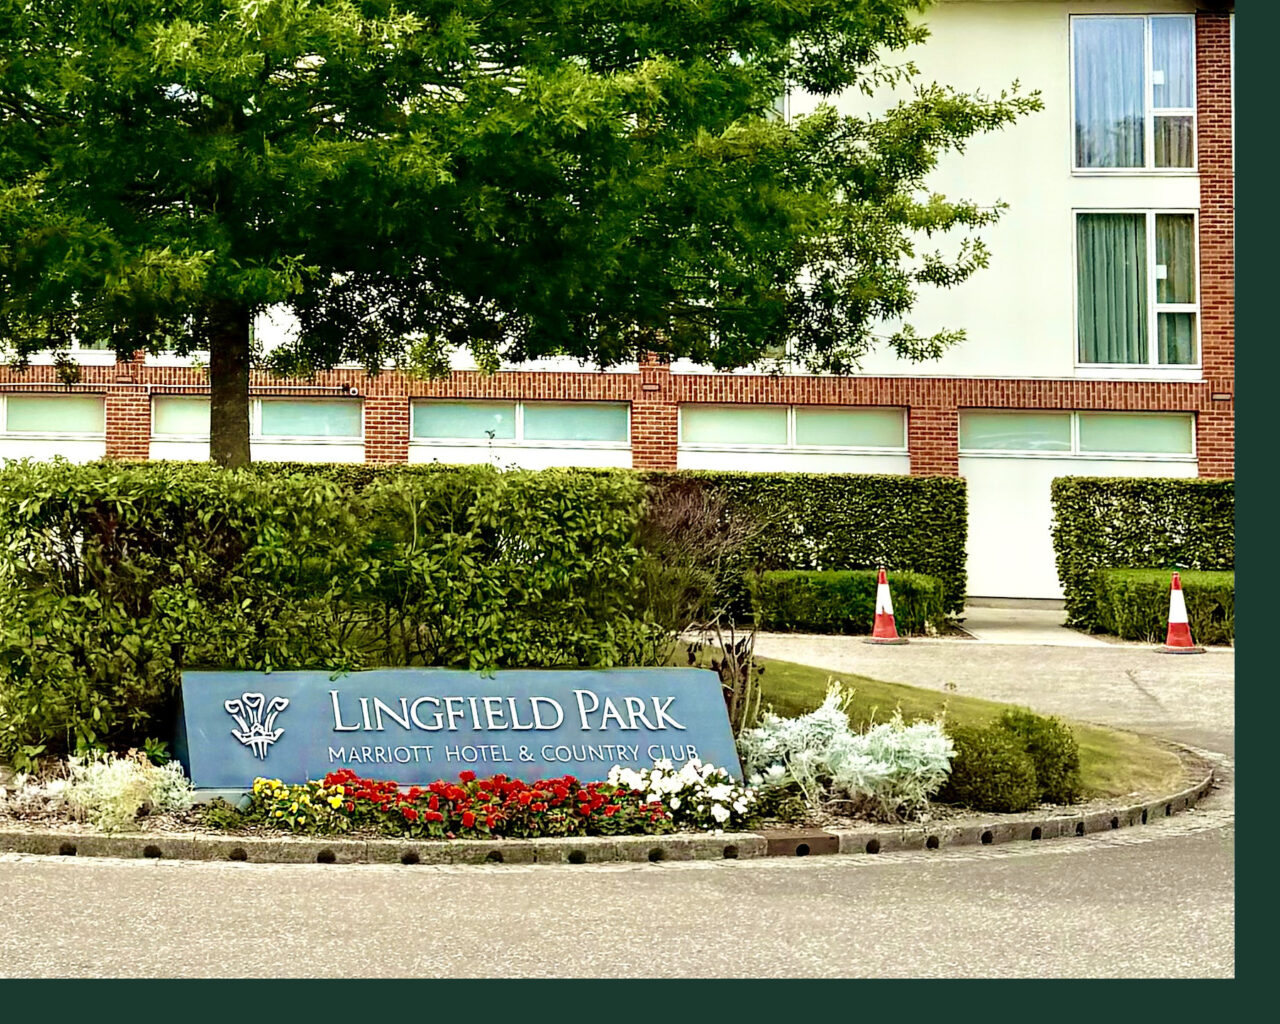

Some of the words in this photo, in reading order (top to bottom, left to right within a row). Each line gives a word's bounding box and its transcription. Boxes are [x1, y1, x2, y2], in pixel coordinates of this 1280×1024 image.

[329, 689, 565, 731] LINGFIELD
[573, 689, 687, 731] PARK
[328, 745, 434, 763] MARRIOTT
[445, 745, 513, 763] HOTEL
[519, 745, 535, 762] &
[541, 745, 639, 763] COUNTRY
[647, 744, 699, 762] CLUB
